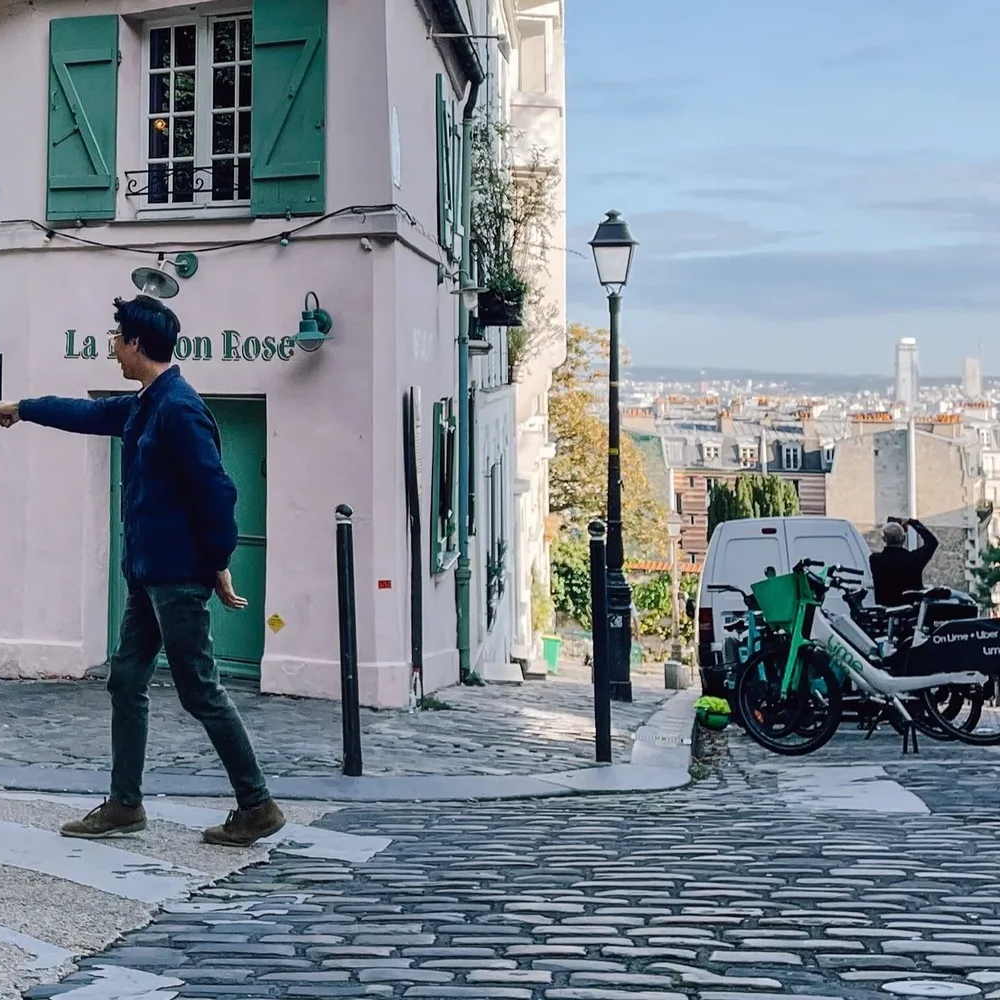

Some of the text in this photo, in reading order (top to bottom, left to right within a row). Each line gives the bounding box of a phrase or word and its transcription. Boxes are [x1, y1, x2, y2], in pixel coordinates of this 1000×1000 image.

[64, 330, 98, 360] La
[221, 330, 295, 361] Rose
[983, 646, 1000, 656] Lim
